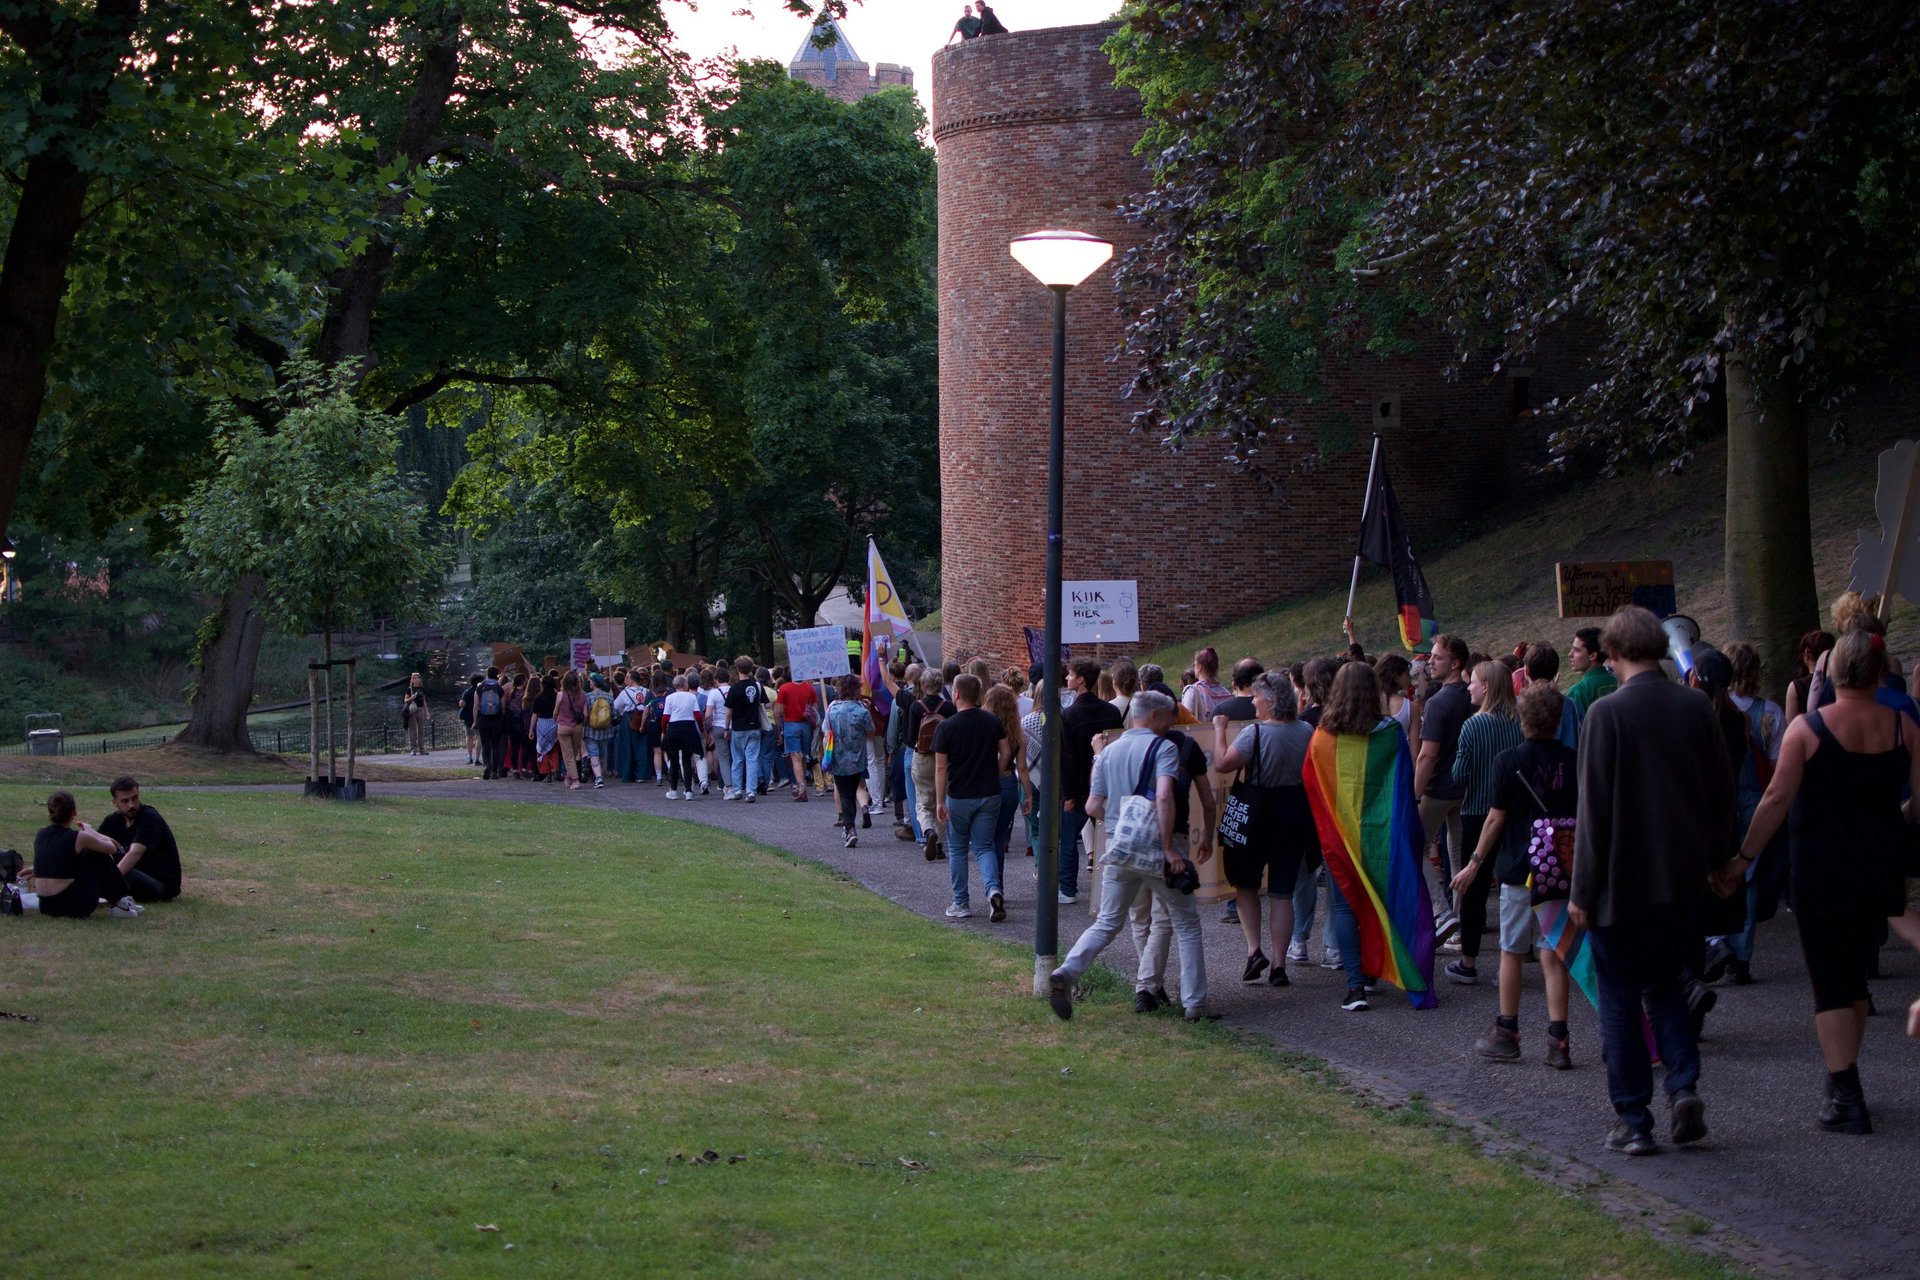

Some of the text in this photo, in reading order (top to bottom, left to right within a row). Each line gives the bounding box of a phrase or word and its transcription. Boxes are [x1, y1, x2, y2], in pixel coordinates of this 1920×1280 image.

[1563, 565, 1608, 581] Women
[1072, 591, 1105, 604] KIJK
[1568, 579, 1601, 596] have
[1605, 577, 1632, 604] body
[1073, 609, 1101, 618] HIER
[1577, 596, 1620, 615] HAIR
